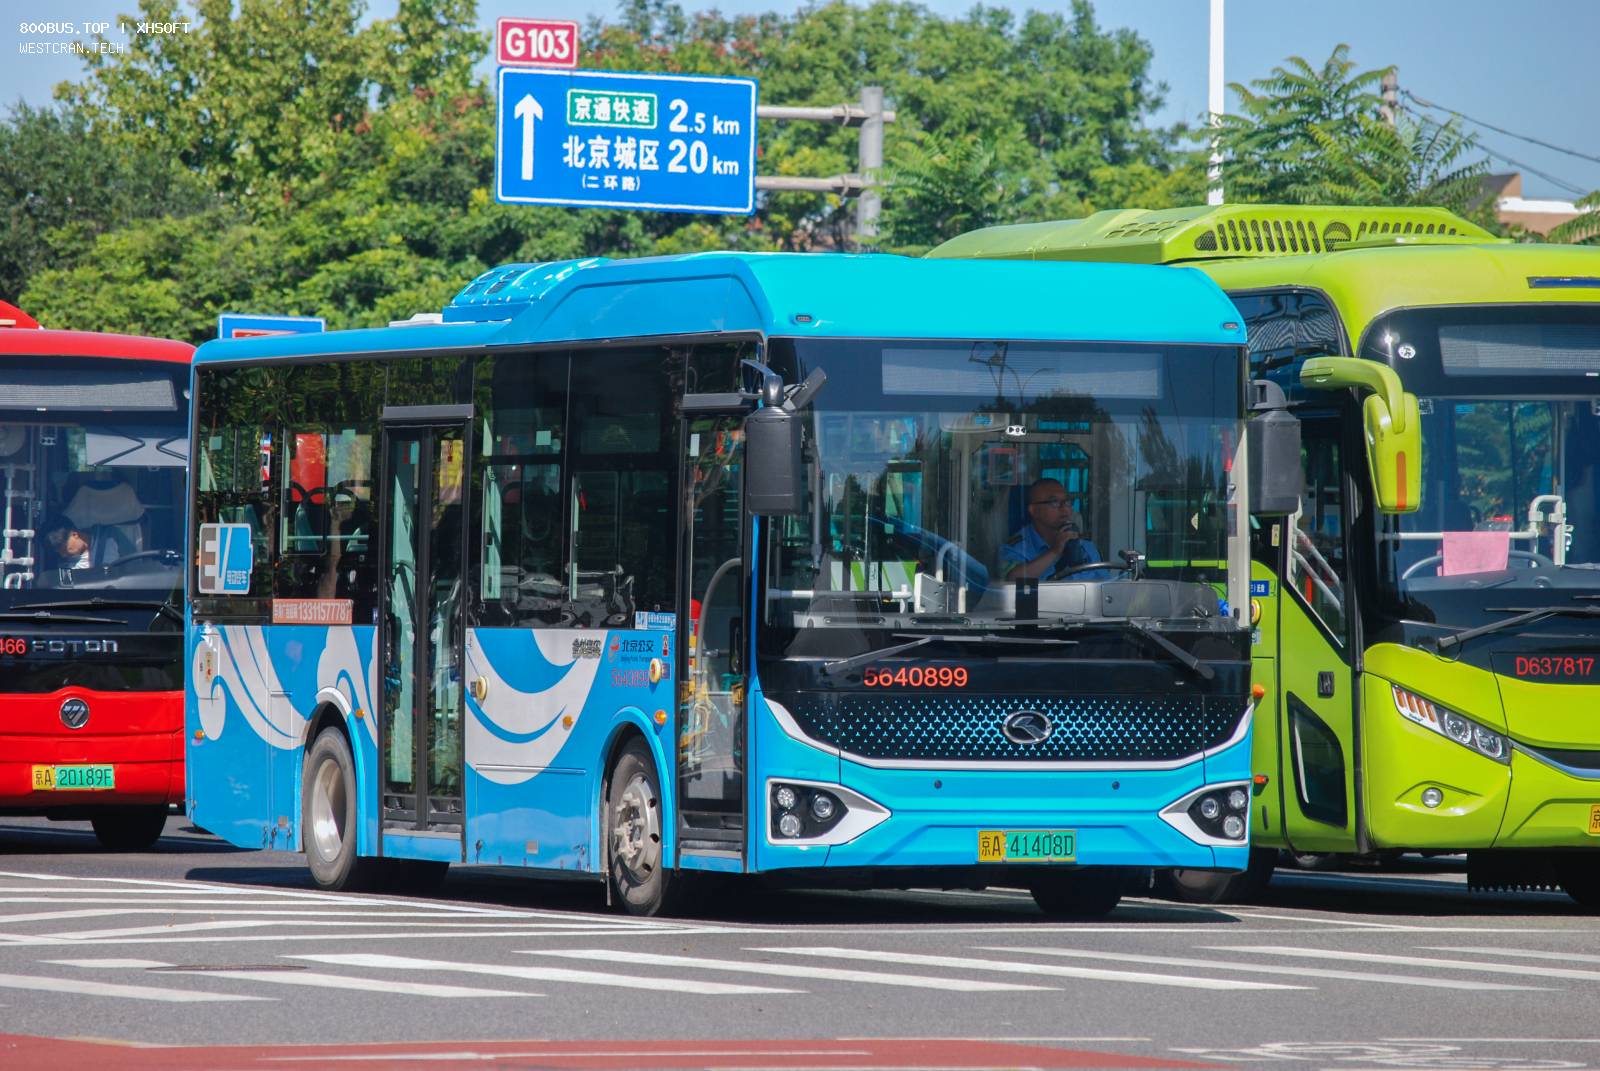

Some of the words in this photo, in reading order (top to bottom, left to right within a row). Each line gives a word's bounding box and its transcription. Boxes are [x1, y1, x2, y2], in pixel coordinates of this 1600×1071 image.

[505, 27, 570, 58] G103
[574, 96, 651, 124] 京通快速
[669, 98, 706, 134] 2.5
[713, 115, 740, 135] km
[563, 135, 660, 171] 北京城区
[668, 139, 708, 174] 20
[712, 156, 739, 175] km
[622, 639, 654, 653] 北京公交
[863, 666, 968, 687] 5640899
[1515, 656, 1594, 676] D637817
